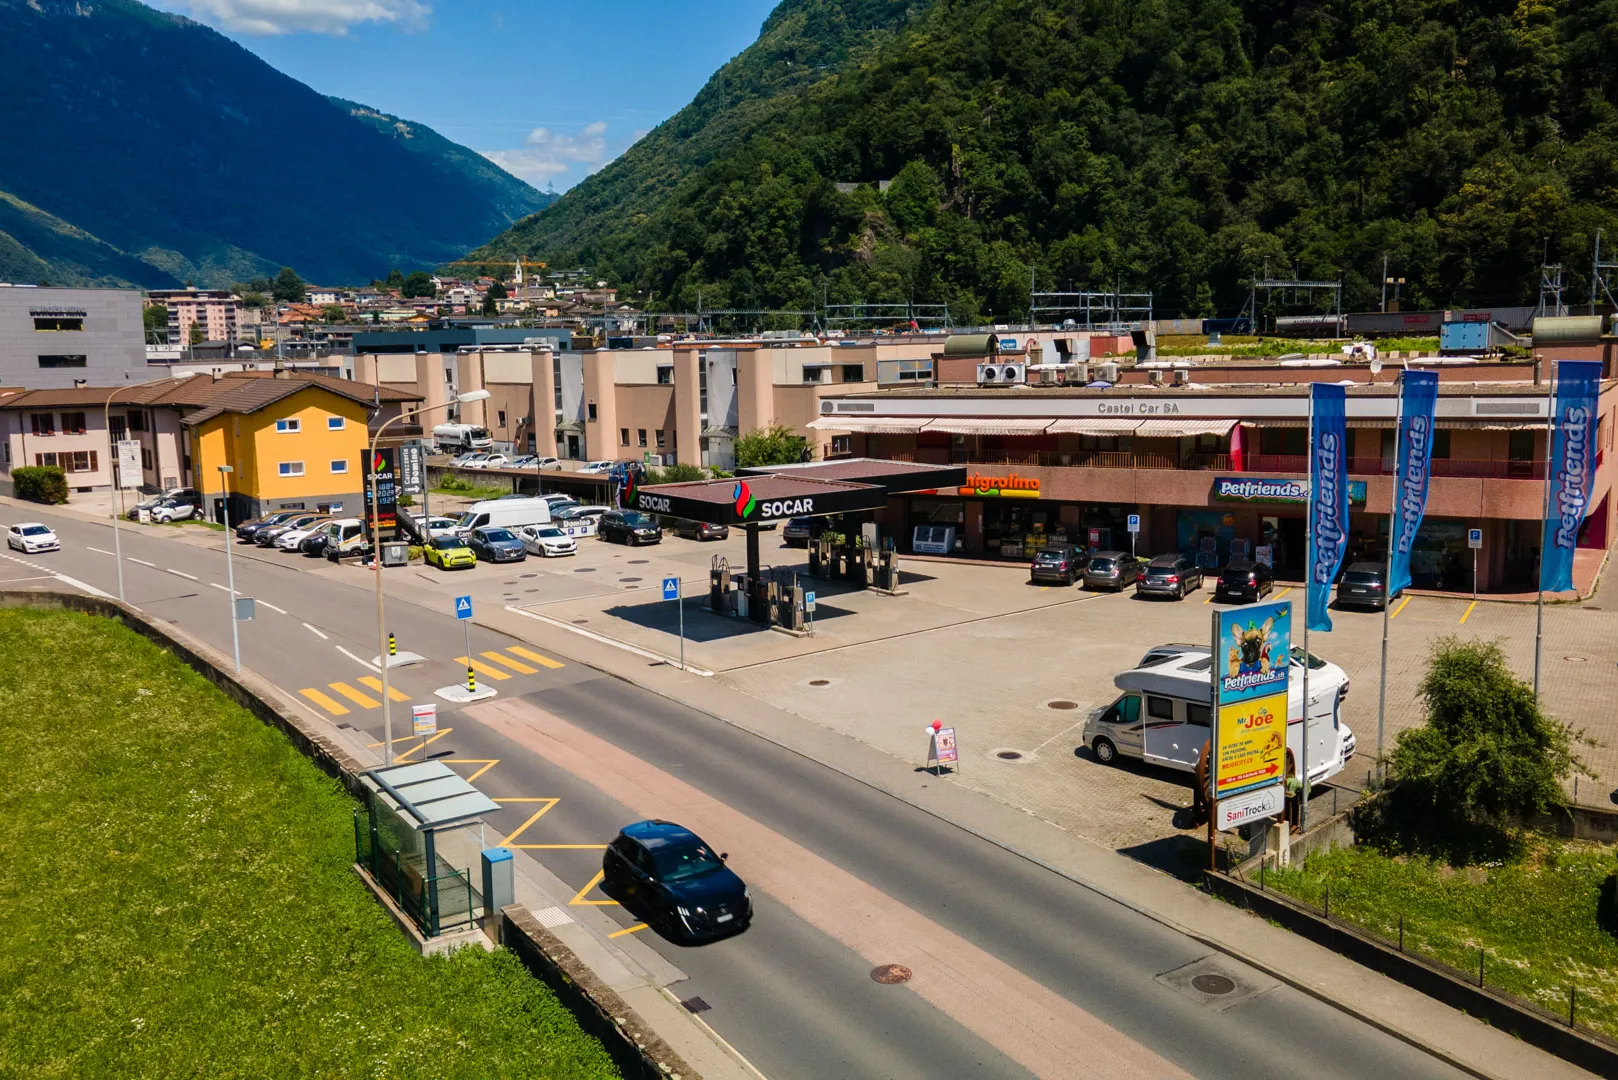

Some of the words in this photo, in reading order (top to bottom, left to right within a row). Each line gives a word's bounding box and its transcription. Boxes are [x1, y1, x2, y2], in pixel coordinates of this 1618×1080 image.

[1098, 402, 1134, 414] Castel
[1139, 402, 1159, 414] Car
[1163, 403, 1179, 414] SA
[410, 447, 420, 484] Domino
[1399, 414, 1428, 554] Petfriends
[1557, 405, 1589, 550] Petfriends
[639, 494, 671, 513] SOCAR
[761, 498, 813, 517] SOCAR
[1314, 432, 1346, 584] Petfriends
[1224, 669, 1285, 689] Petfriends.ch
[1244, 713, 1274, 729] Joe
[1226, 802, 1267, 822] SaniTrock
